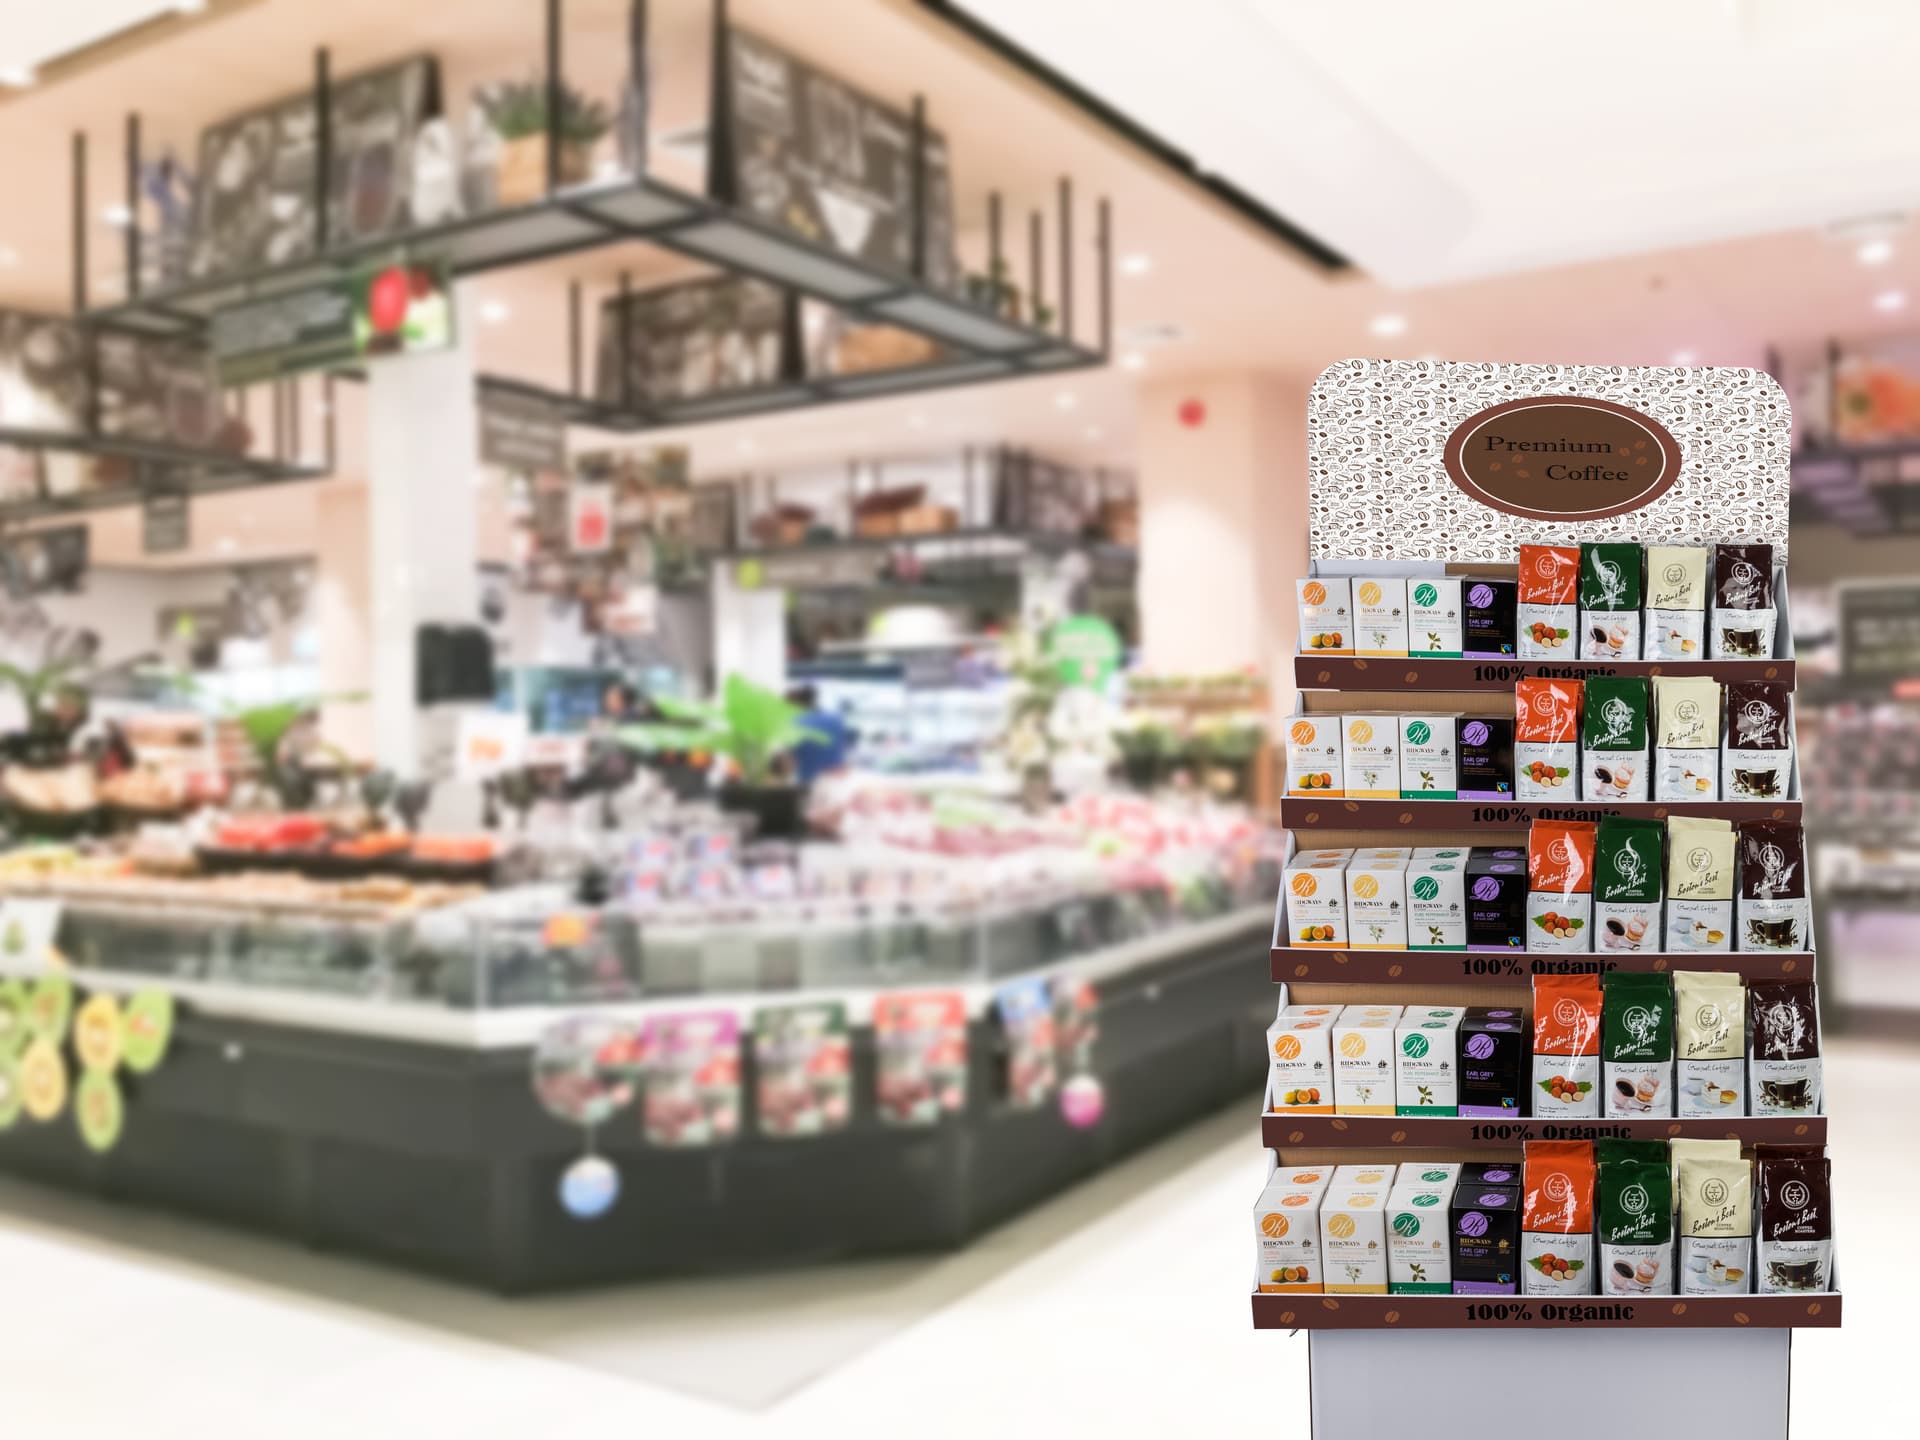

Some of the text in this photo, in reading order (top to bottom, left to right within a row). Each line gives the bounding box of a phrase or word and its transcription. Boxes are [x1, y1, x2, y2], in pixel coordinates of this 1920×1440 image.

[1485, 436, 1611, 453] Premium
[1547, 464, 1629, 481] Coffee
[1473, 666, 1529, 681] 100%
[1472, 808, 1530, 822] 100%
[1463, 959, 1617, 975] 100% Organic
[1471, 1125, 1631, 1140] 100% Organic
[1611, 1212, 1656, 1241] Boston's Best
[1692, 1205, 1736, 1233] Boston's Best
[1773, 1207, 1818, 1236] Boston's Best
[1466, 1304, 1634, 1322] 100% Organic
